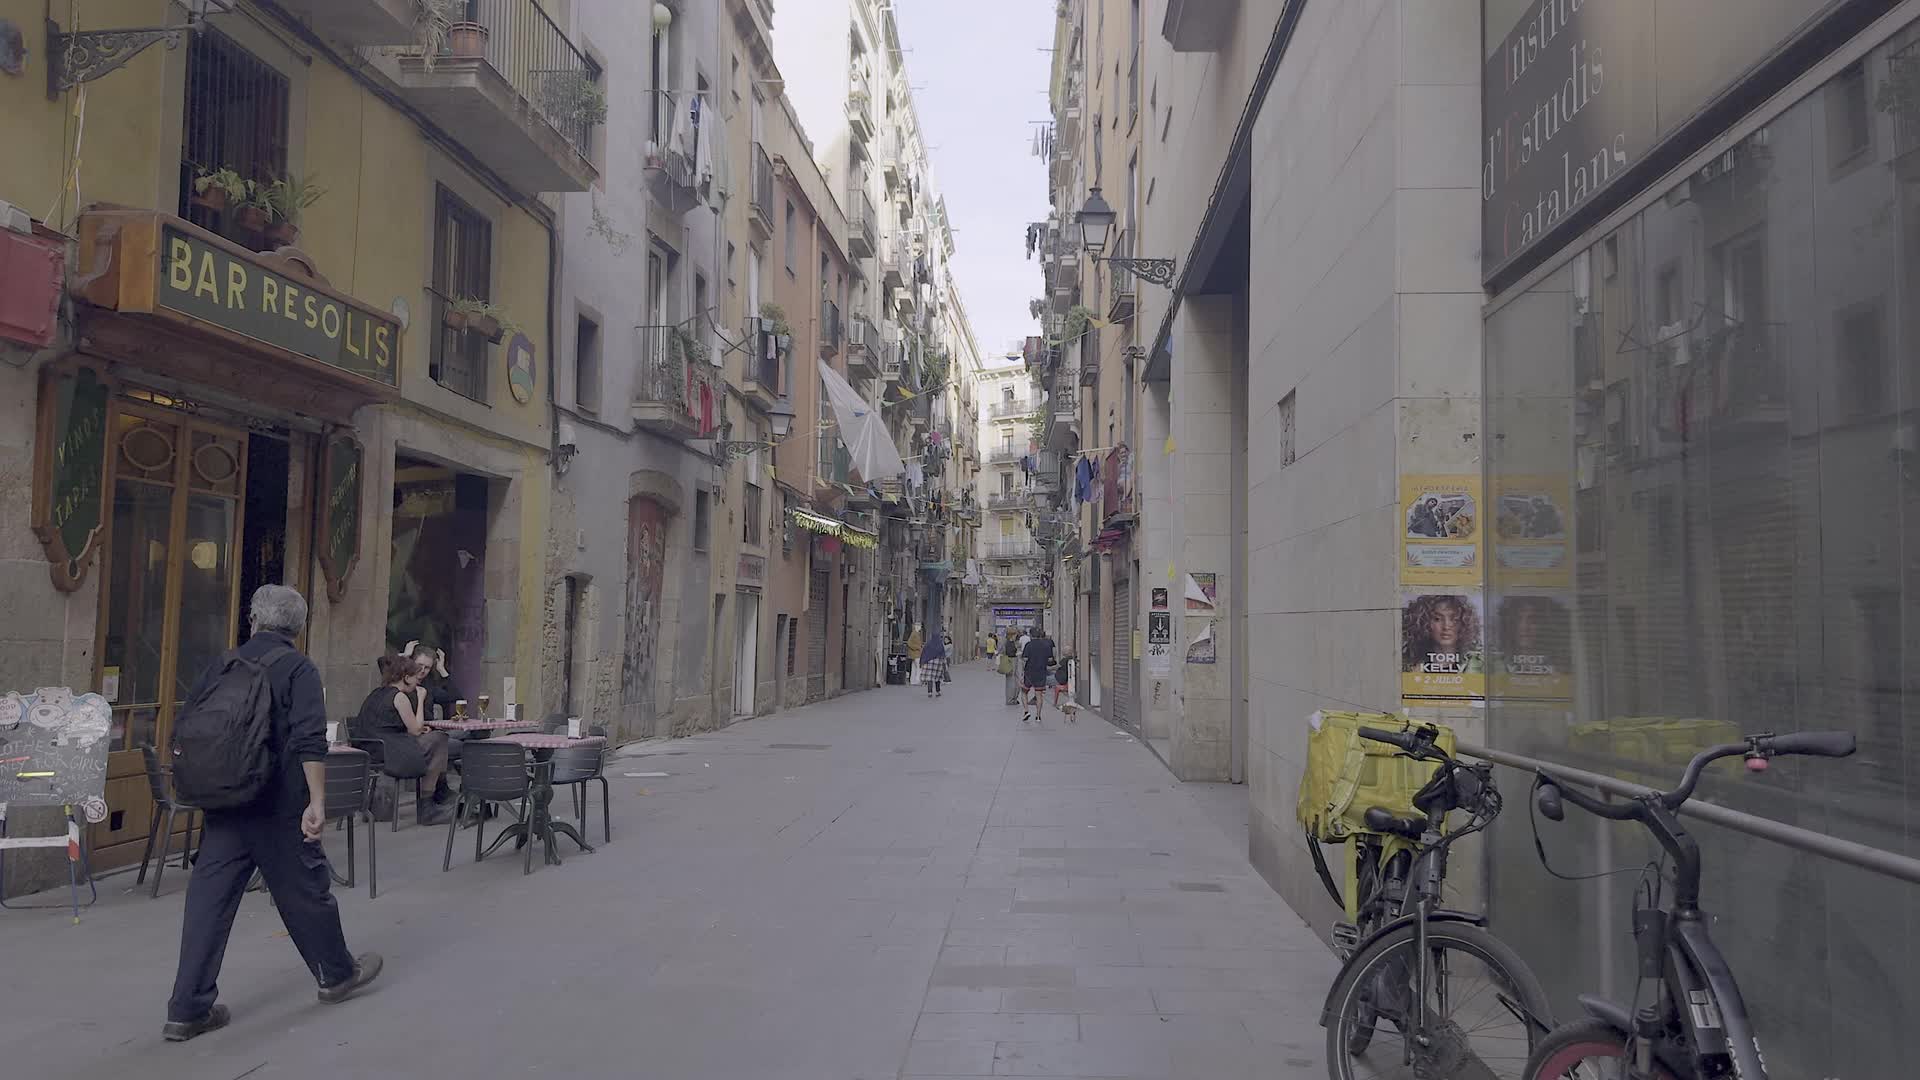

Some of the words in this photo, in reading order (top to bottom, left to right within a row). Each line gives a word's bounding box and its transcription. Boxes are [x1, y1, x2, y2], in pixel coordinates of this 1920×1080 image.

[169, 236, 248, 310] BAR
[262, 275, 390, 368] RESOLIS
[1427, 652, 1459, 663] TORI
[1420, 663, 1467, 673] KELLY
